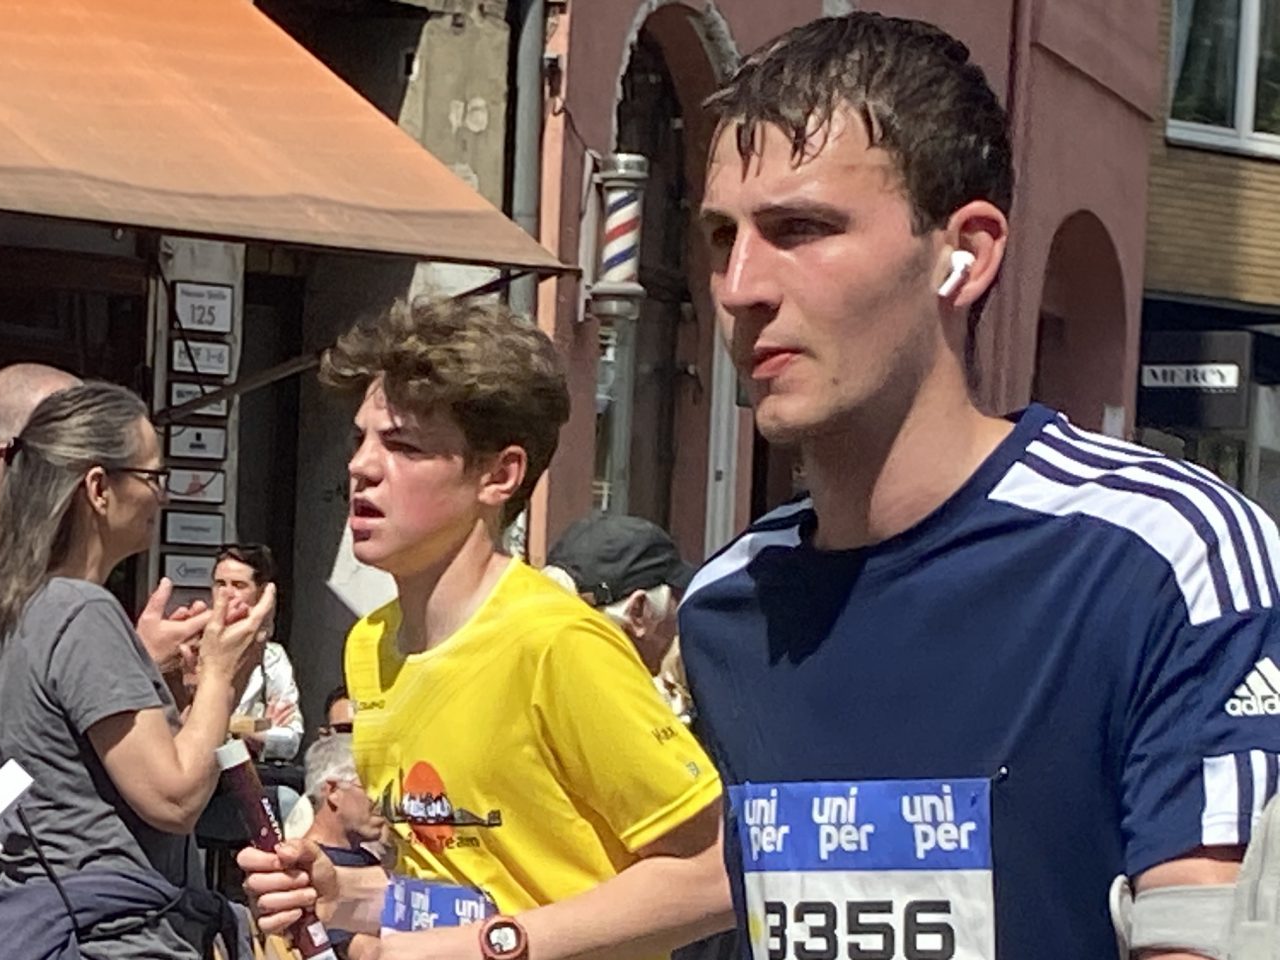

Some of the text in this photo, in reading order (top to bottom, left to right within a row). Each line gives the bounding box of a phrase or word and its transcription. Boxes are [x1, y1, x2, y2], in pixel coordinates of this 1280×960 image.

[190, 304, 216, 325] 125
[744, 784, 955, 825] uni uni uni
[750, 821, 977, 861] per per per
[455, 896, 485, 920] uni
